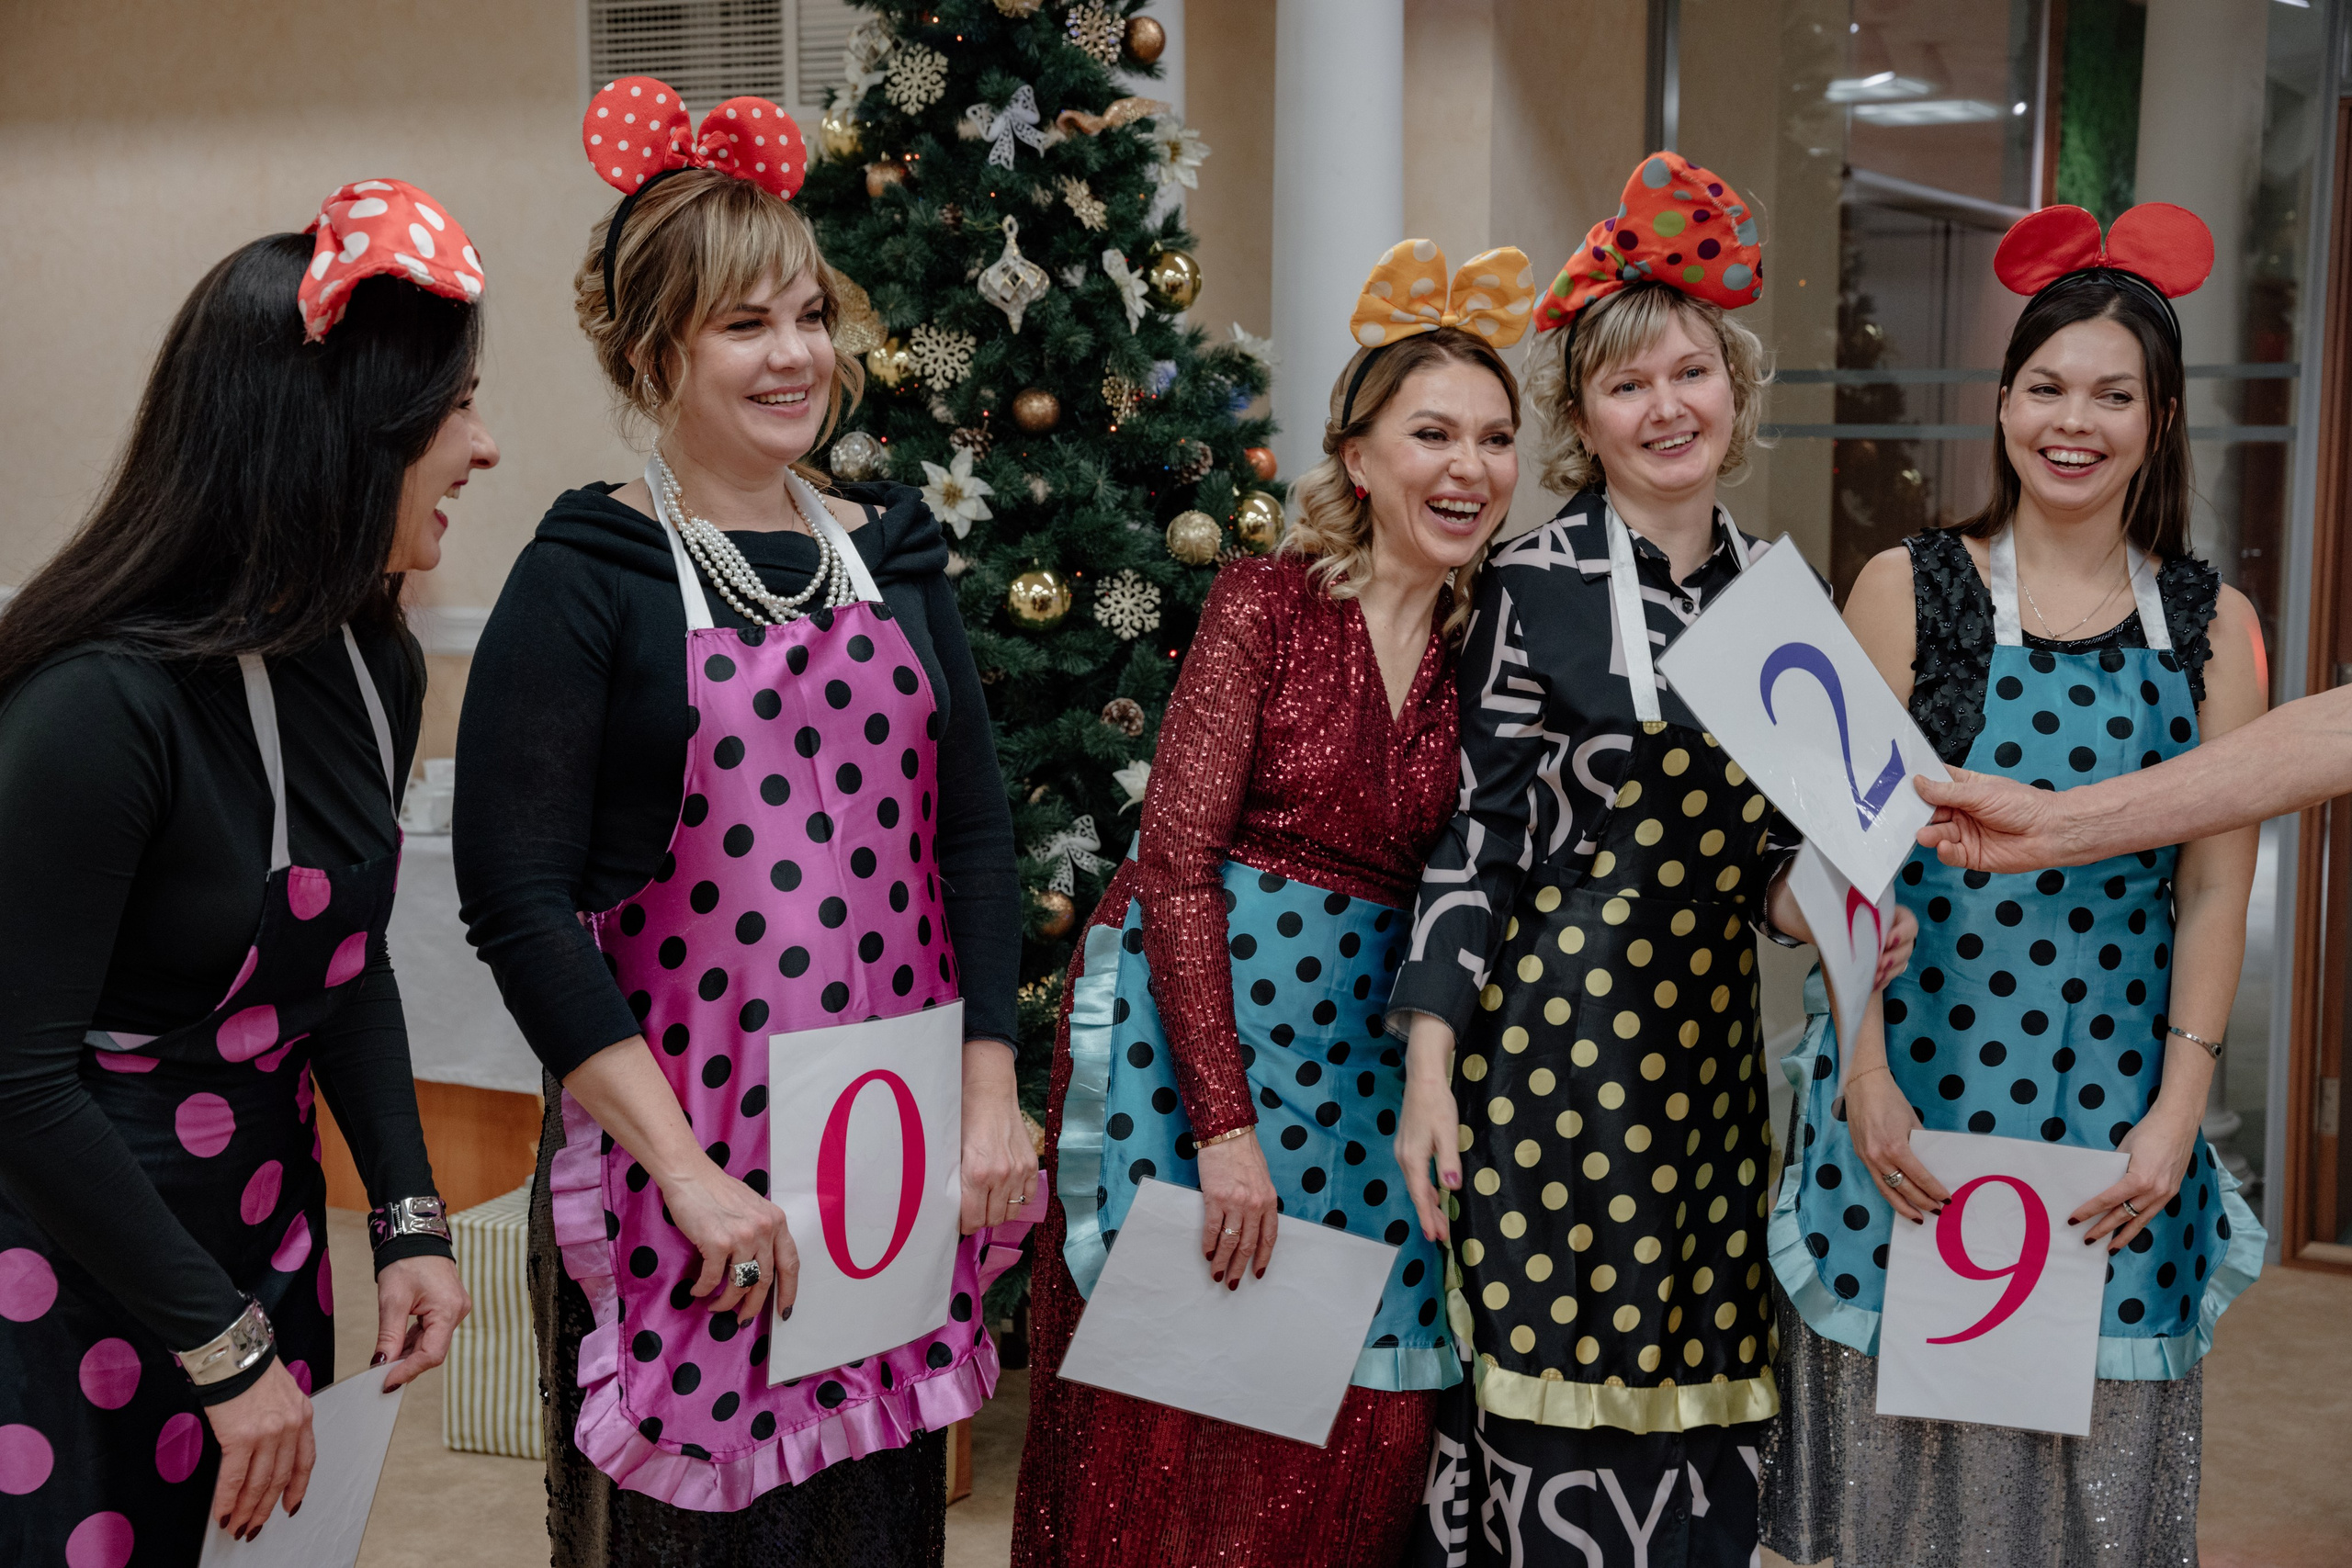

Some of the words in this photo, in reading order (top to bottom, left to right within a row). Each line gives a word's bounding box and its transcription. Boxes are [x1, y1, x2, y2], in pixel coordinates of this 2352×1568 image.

[1758, 642, 1907, 833] 2
[816, 1068, 926, 1280] 0
[1926, 1174, 2051, 1345] 9
